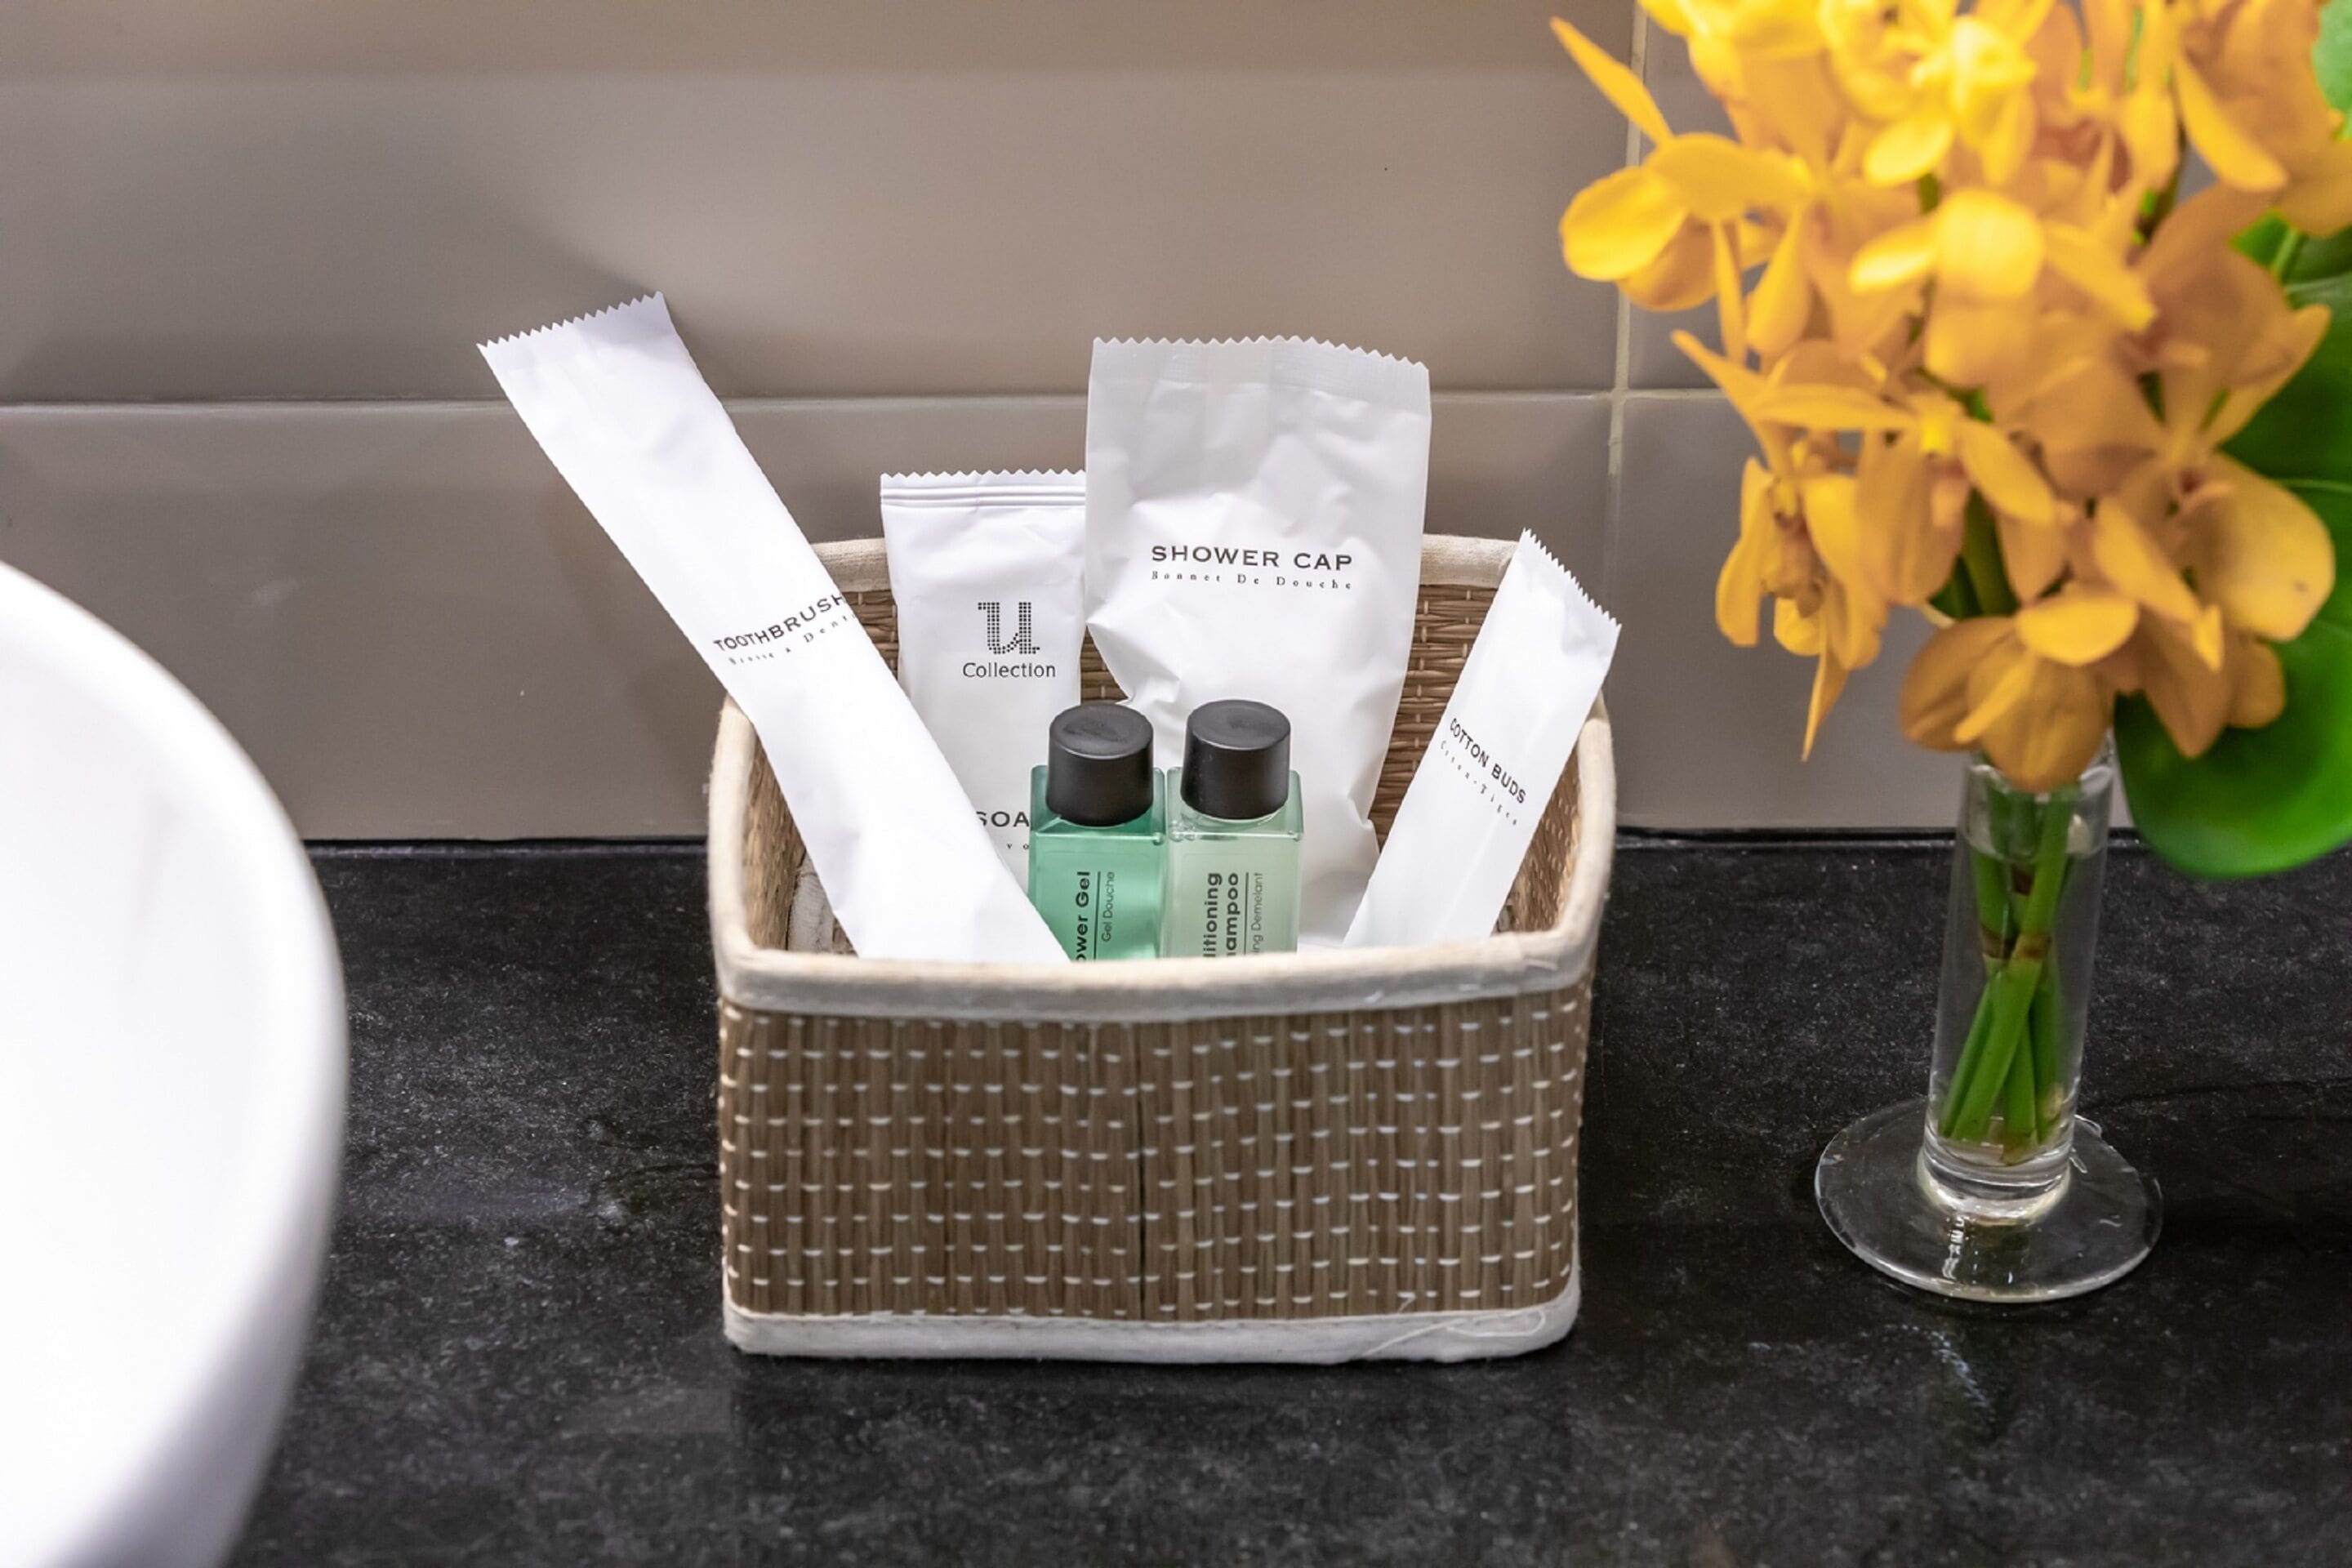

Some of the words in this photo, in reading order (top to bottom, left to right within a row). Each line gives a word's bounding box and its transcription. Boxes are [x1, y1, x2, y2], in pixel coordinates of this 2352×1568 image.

[1152, 545, 1280, 568] SHOWER
[1293, 552, 1352, 571] CAP
[1152, 571, 1221, 582] Bonnet
[1236, 573, 1260, 585] De
[1276, 576, 1352, 590] Douche
[963, 662, 1056, 678] Collection
[1450, 717, 1490, 768] COTTON
[1491, 763, 1526, 804] BUDS
[1075, 871, 1090, 908] Gel
[1102, 871, 1116, 919] Douche
[1250, 873, 1263, 931] Demelant
[1101, 922, 1113, 942] Gel
